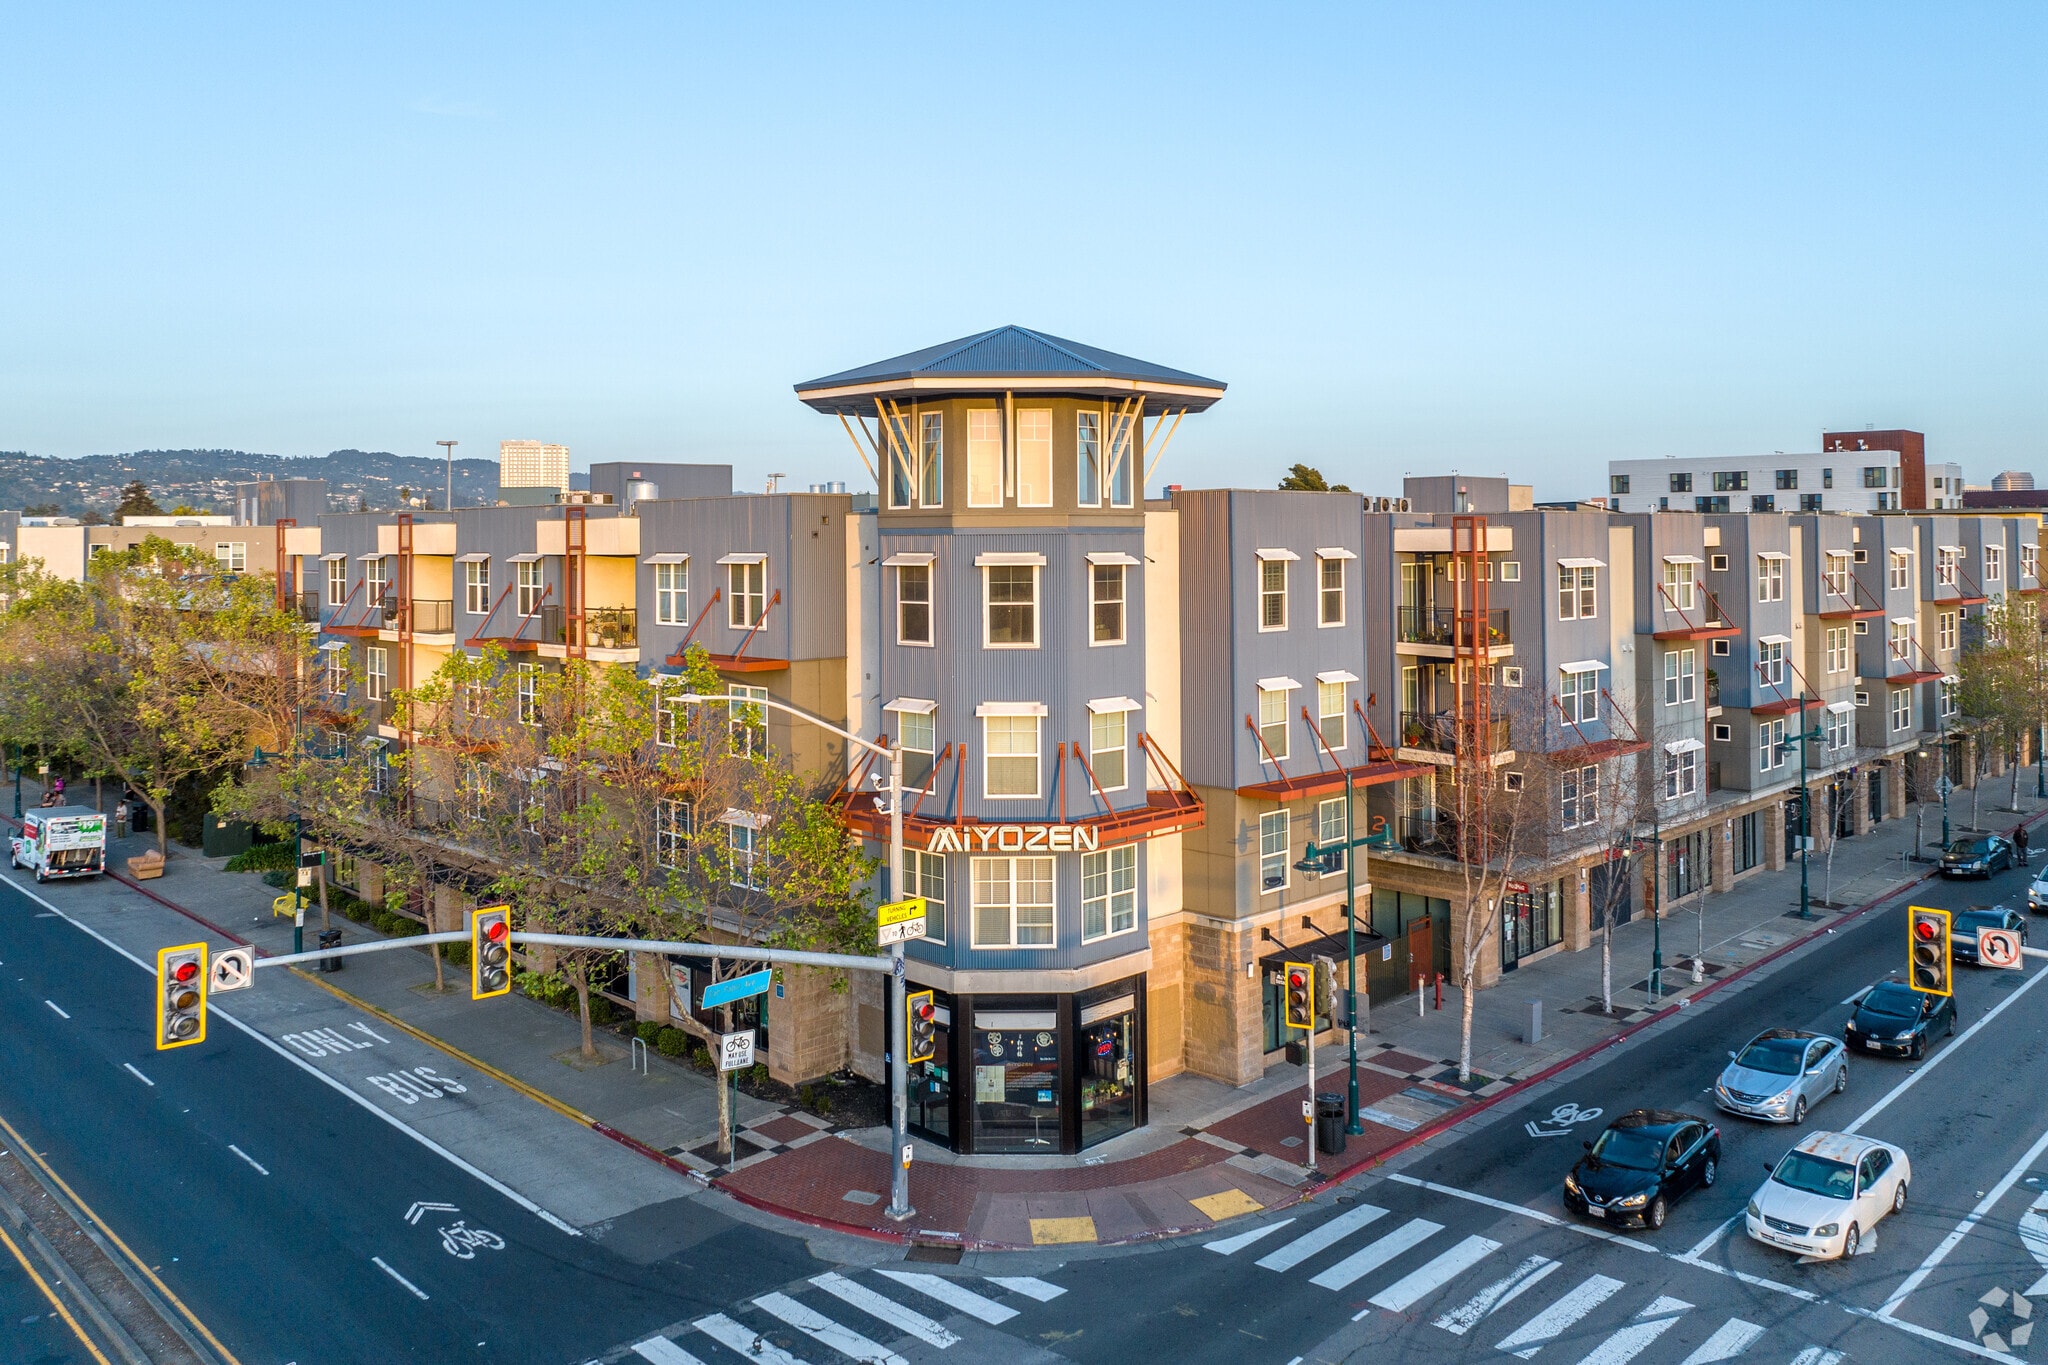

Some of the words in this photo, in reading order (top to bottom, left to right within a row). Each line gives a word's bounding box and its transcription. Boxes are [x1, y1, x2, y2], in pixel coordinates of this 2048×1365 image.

[887, 905, 906, 914] TURNING
[886, 913, 908, 922] VEHICLES
[282, 1021, 391, 1058] ONLY
[1098, 1043, 1112, 1055] OPEN
[365, 1066, 468, 1105] BUS
